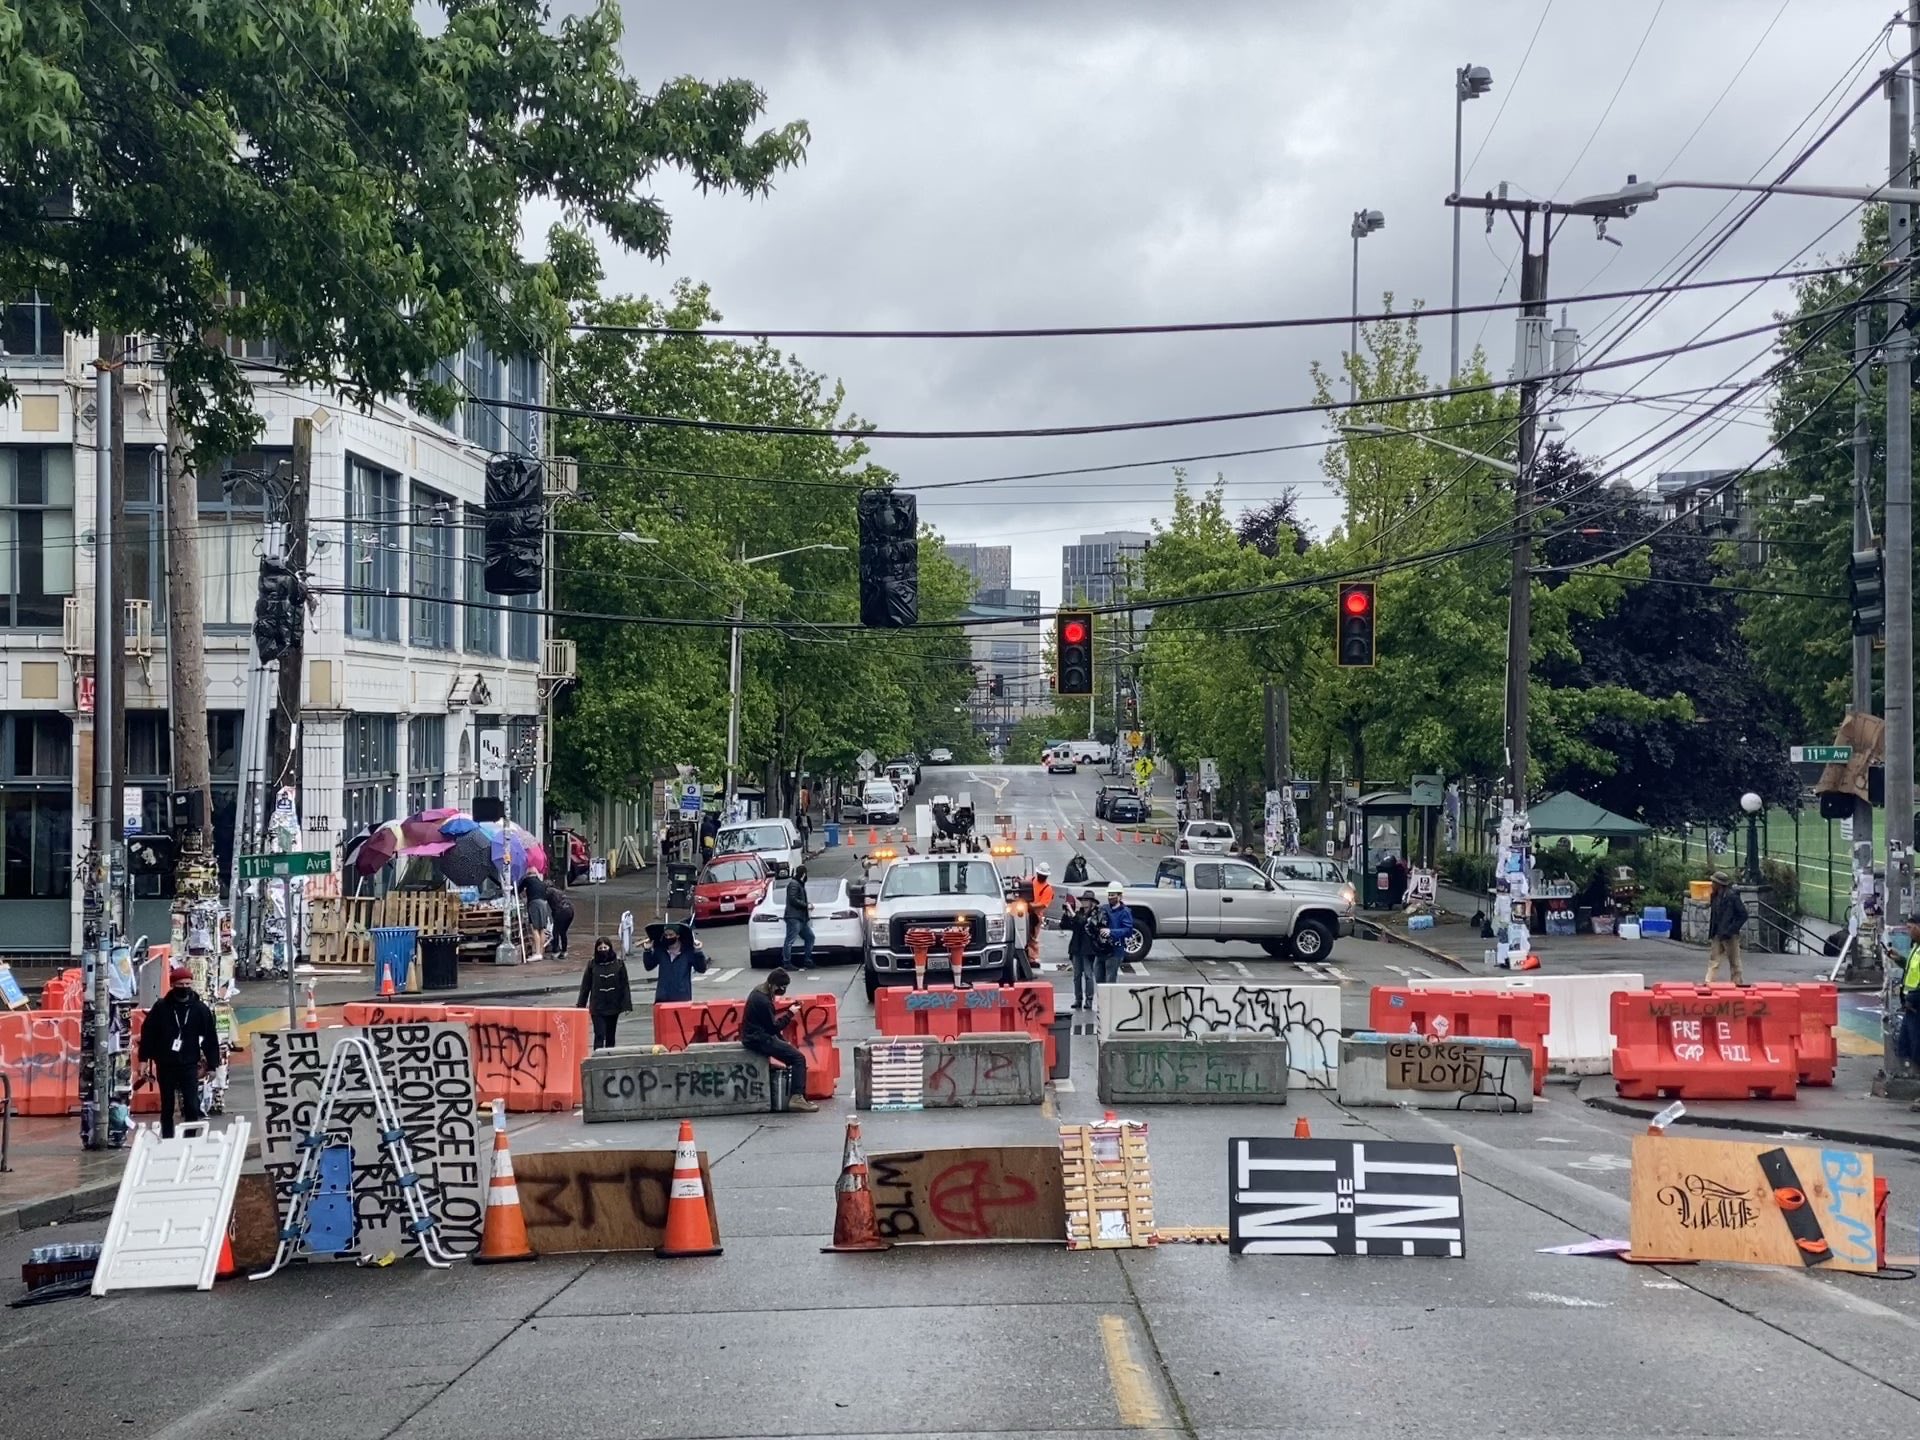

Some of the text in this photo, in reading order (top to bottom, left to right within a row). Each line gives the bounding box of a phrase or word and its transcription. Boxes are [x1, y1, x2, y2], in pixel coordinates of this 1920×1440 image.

[1833, 750, 1848, 760] Ave
[245, 858, 327, 876] 11th Ave
[1648, 1000, 1769, 1018] WELCOME 2
[286, 1031, 322, 1097] ERIC
[1390, 1042, 1477, 1064] GEORGE
[1674, 1045, 1704, 1061] CAP
[1127, 1070, 1268, 1091] CAP HILL
[1401, 1061, 1478, 1084] FLOYD
[261, 1033, 292, 1153] MICHAEL
[397, 1025, 439, 1163] BREONNA
[433, 1030, 484, 1257] GEORGE FLOYD
[354, 1164, 388, 1230] RICE
[870, 1152, 925, 1238] BLM
[1337, 1178, 1354, 1214] BE
[1821, 1146, 1877, 1264] BLM
